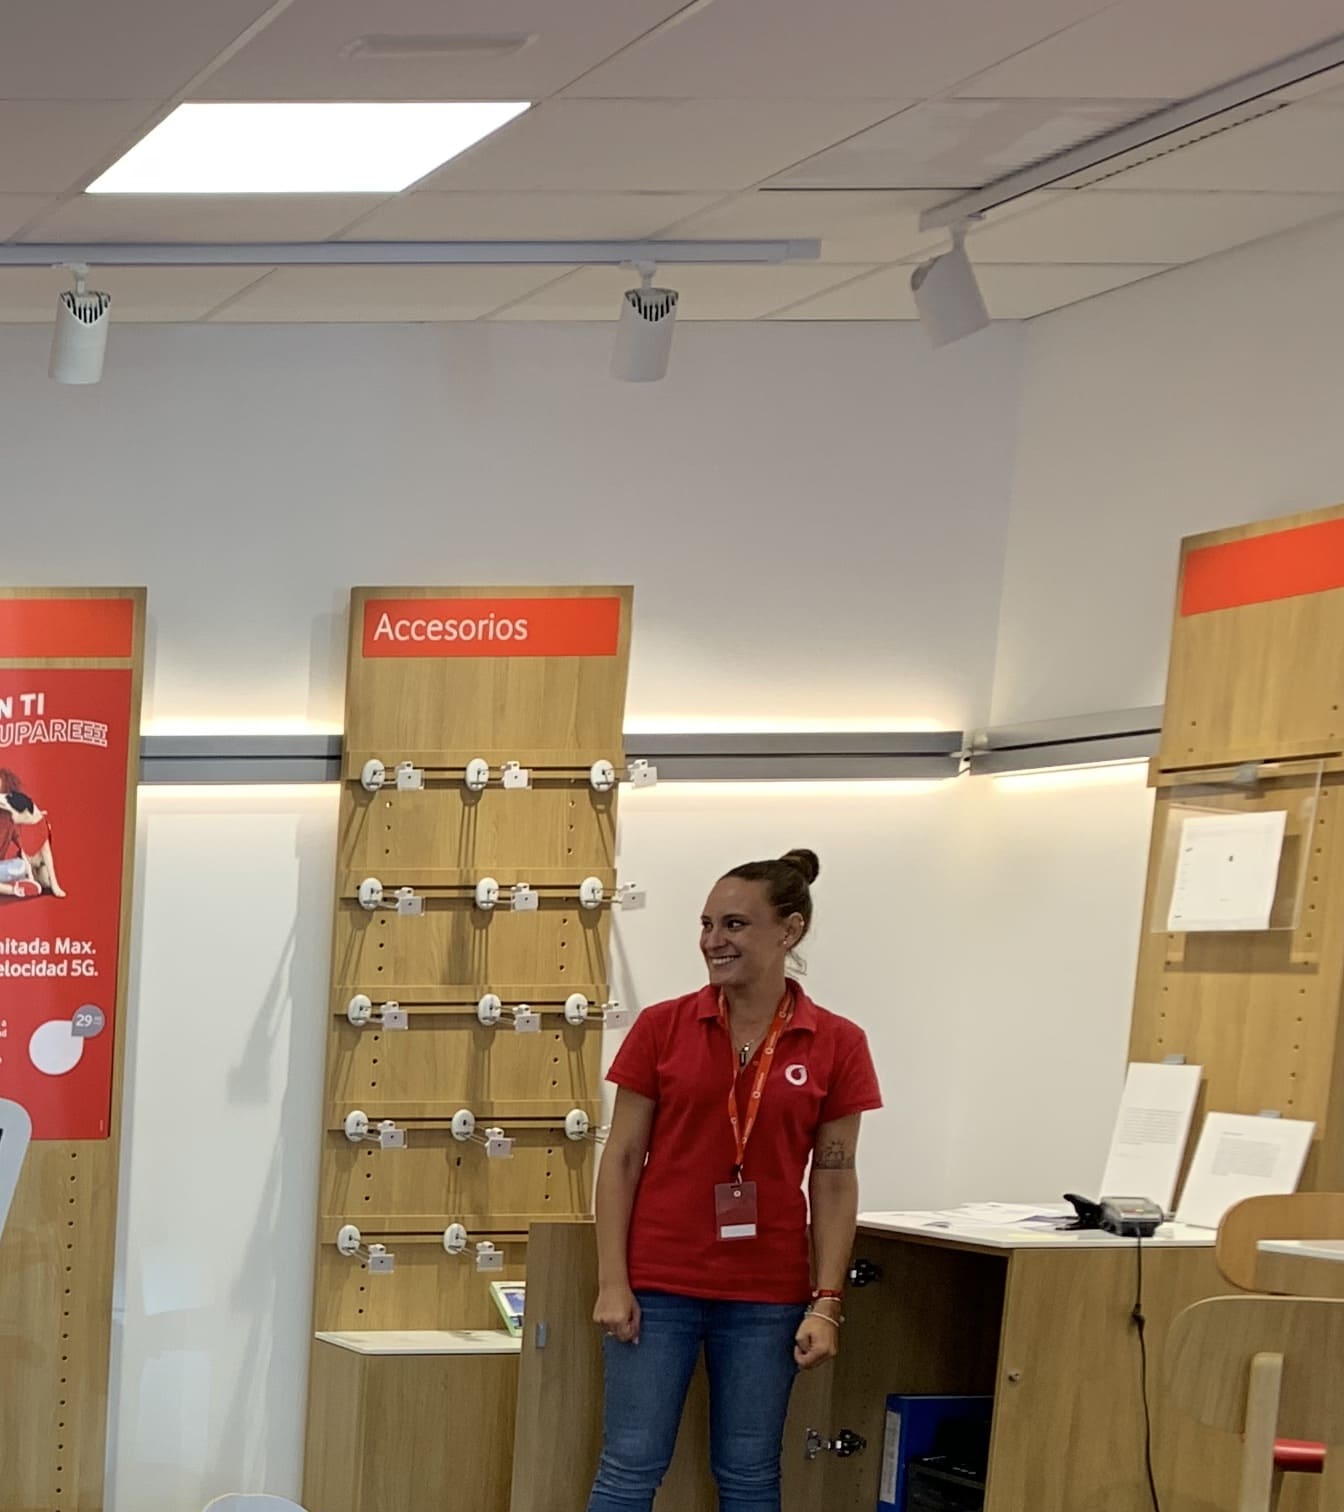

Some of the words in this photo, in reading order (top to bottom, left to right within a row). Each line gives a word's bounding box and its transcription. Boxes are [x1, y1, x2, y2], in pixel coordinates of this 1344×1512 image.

[372, 612, 528, 641] Accesorios
[19, 692, 45, 716] TI
[54, 937, 97, 954] Max.
[70, 959, 99, 977] 5G.
[75, 1013, 93, 1027] 29
